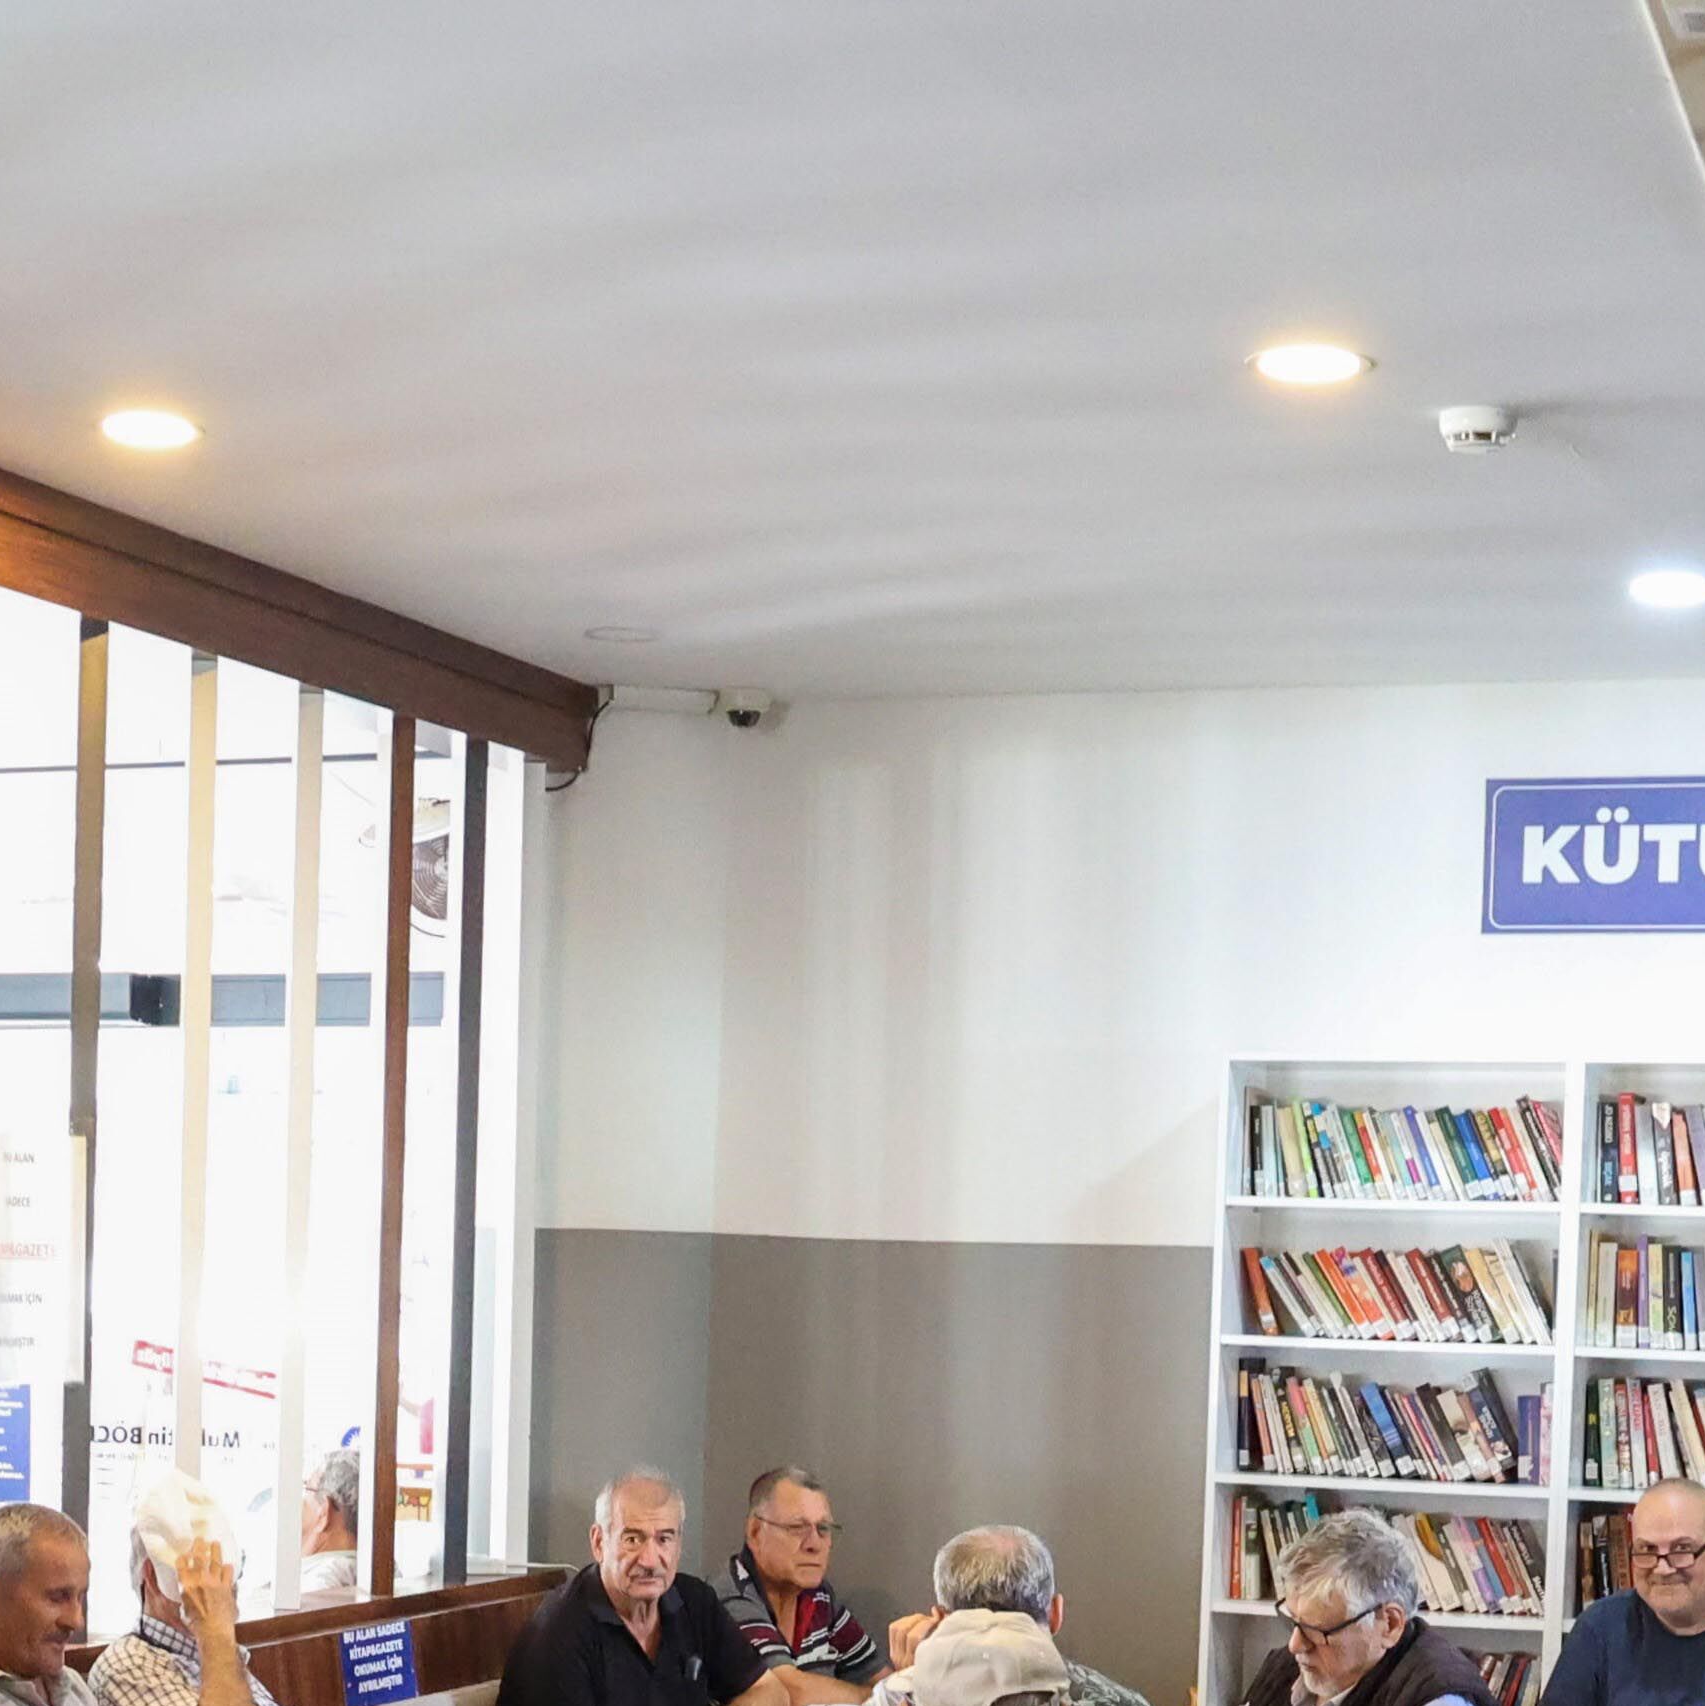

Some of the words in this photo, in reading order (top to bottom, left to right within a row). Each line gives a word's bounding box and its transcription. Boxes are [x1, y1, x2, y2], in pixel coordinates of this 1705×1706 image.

[343, 1631, 354, 1644] BU
[356, 1627, 376, 1642] ALAN
[377, 1621, 406, 1637] SADECE
[354, 1659, 387, 1677] OKUMAK
[387, 1653, 403, 1672] İÇİN
[358, 1673, 403, 1694] AYRILMIŞTIR
